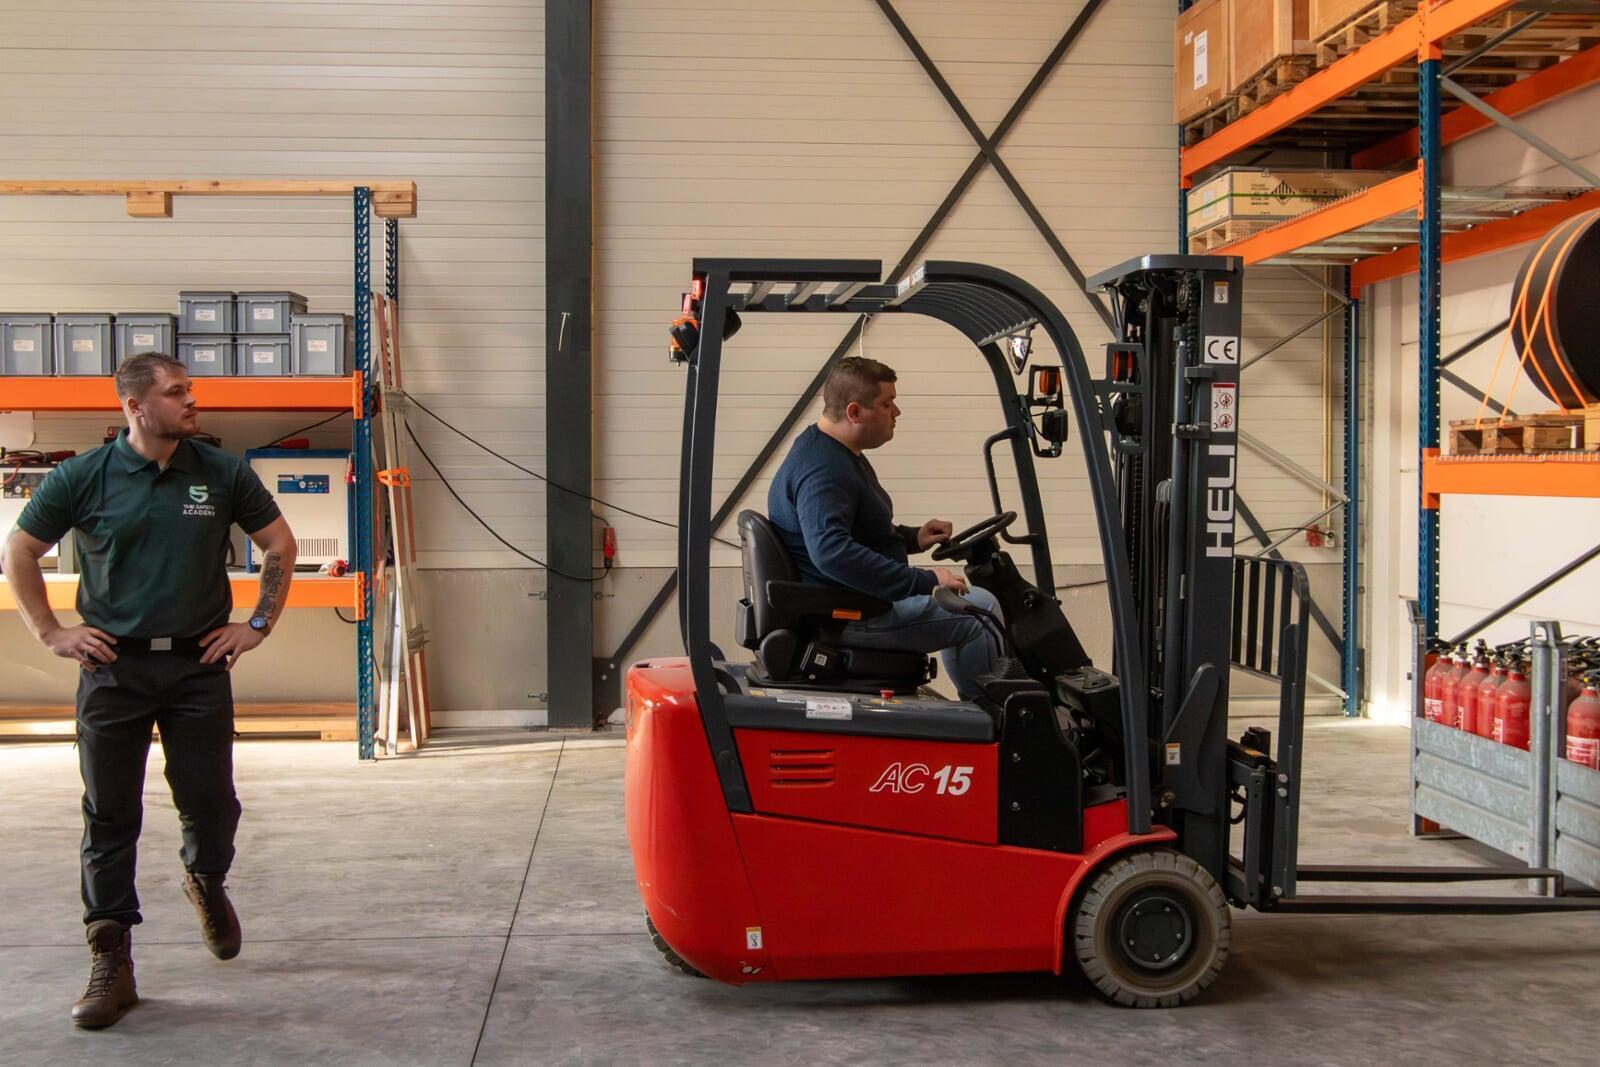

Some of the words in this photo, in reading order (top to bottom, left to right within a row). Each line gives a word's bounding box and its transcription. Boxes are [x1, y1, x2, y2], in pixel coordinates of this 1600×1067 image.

[1207, 339, 1235, 360] CE
[182, 509, 216, 517] ACADEMY
[1206, 445, 1235, 557] HELI
[869, 762, 930, 793] AC
[933, 765, 974, 796] 15
